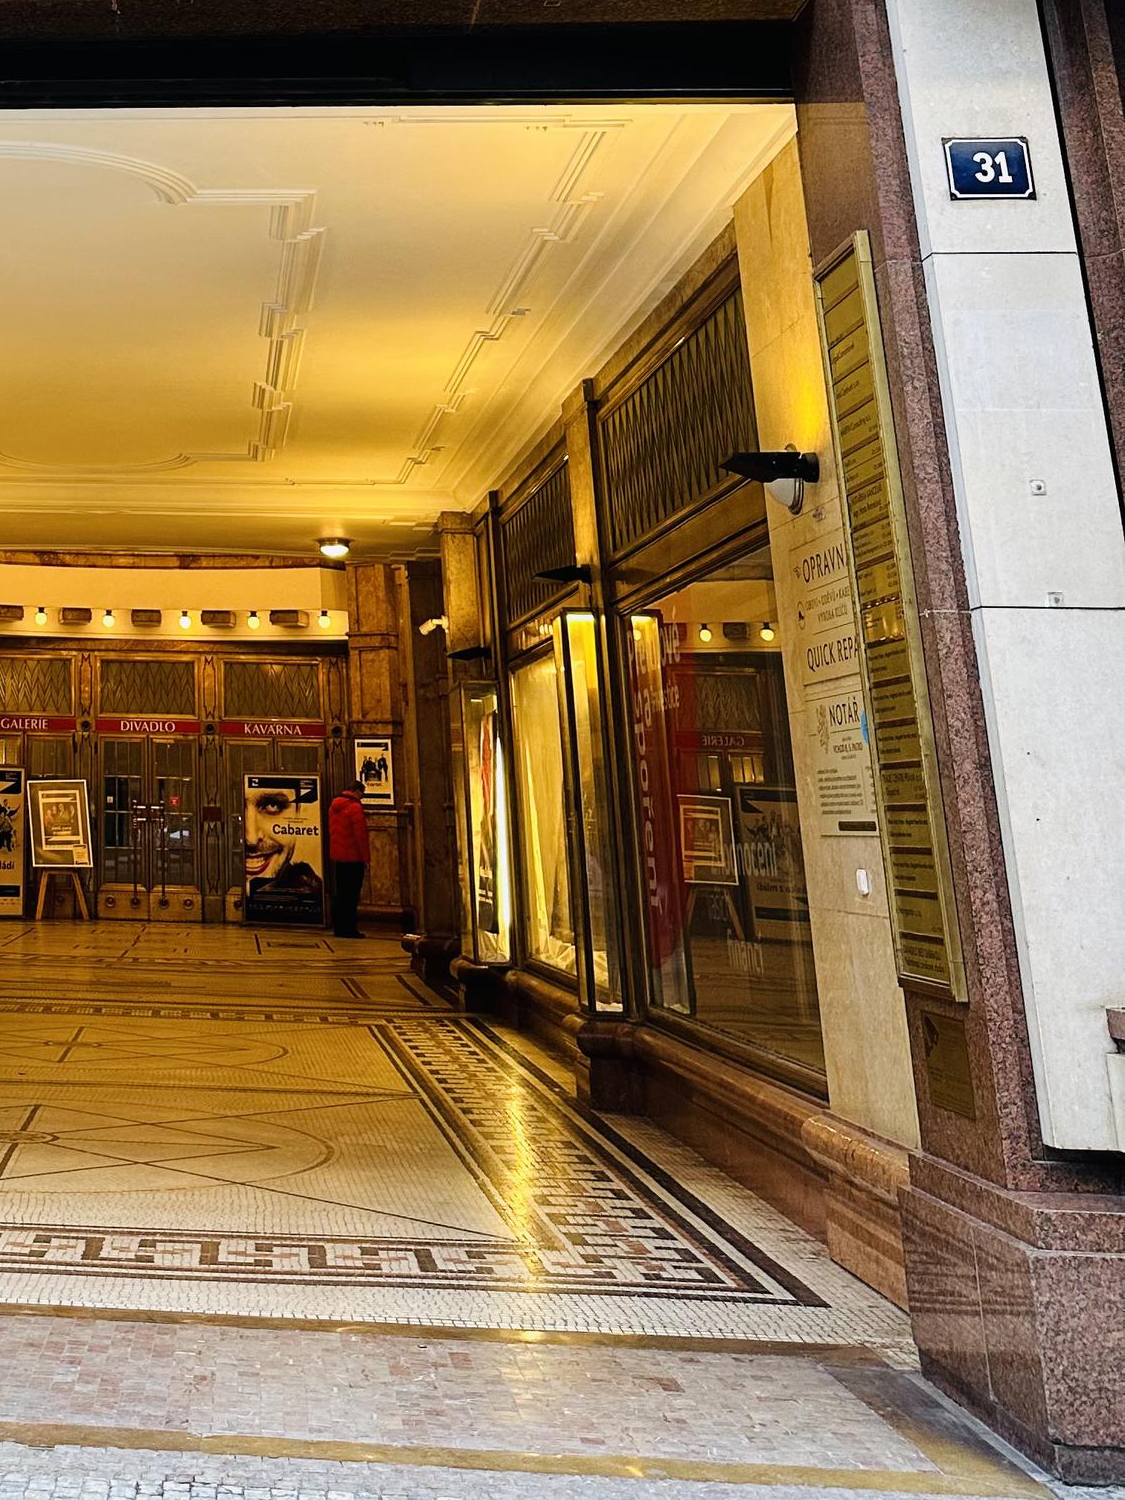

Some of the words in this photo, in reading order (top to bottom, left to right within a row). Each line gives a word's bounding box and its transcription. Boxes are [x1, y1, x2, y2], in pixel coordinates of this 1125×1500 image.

[973, 151, 1013, 183] 31
[801, 543, 848, 584] OPRAVN
[838, 584, 850, 599] KABE
[807, 641, 837, 673] QUICK
[837, 636, 859, 662] REPA
[829, 697, 861, 728] NOTÁŘ
[0, 717, 48, 730] GALERIE
[120, 720, 176, 733] DIVADLO
[244, 723, 302, 736] KAVÁRNA
[272, 823, 319, 836] Cabaret
